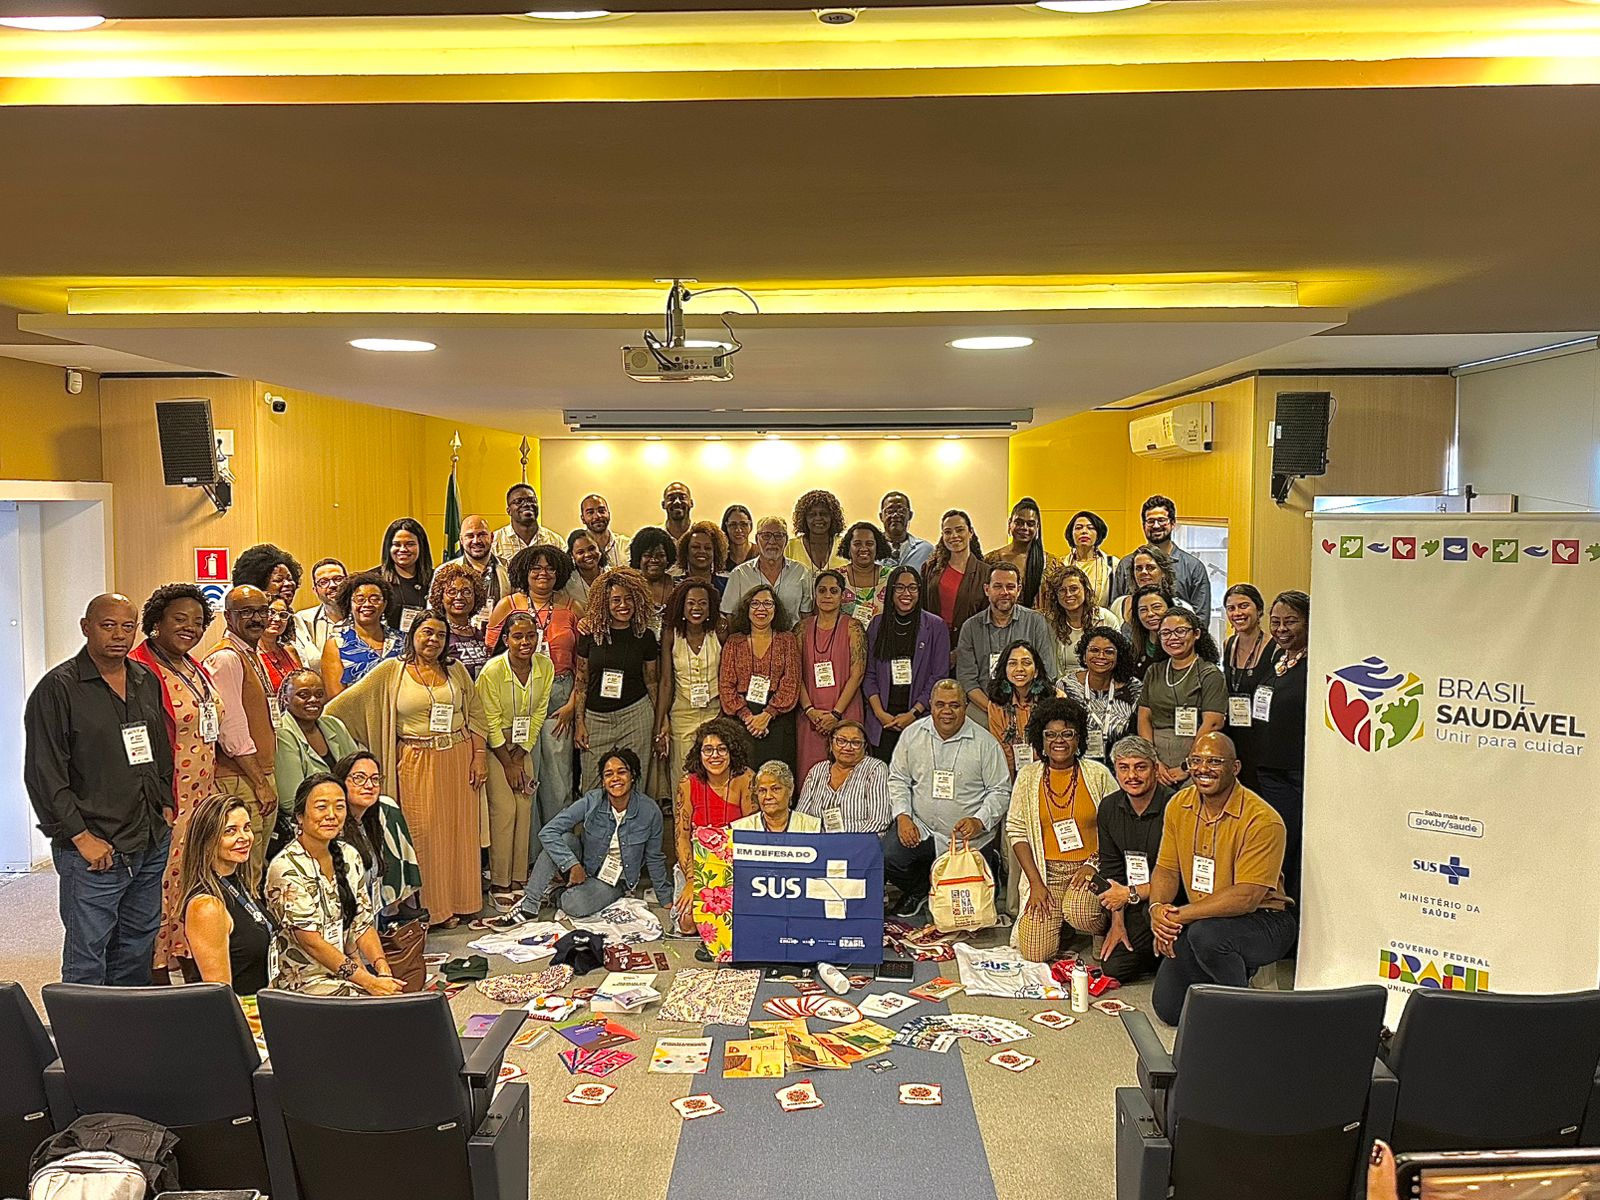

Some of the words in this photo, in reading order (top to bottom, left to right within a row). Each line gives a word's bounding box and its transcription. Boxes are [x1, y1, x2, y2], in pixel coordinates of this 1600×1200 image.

[1438, 678, 1536, 705] BRASIL
[1436, 704, 1586, 738] SAUDÁVEL
[1436, 728, 1471, 744] Unir
[1478, 735, 1517, 750] para
[1524, 735, 1584, 756] cuidar
[1424, 810, 1442, 818] Saiba
[1415, 818, 1478, 832] gov.br/saude
[736, 848, 753, 856] EM
[754, 850, 794, 858] DEFESA
[1412, 859, 1437, 873] SUS
[751, 876, 802, 899] SUS
[1399, 892, 1462, 910] MINISTÉRIO
[1466, 904, 1480, 913] DA
[1422, 907, 1457, 920] SAÚDE
[1390, 940, 1439, 956] GOVERNO
[1443, 951, 1490, 967] FEDERAL
[980, 960, 1010, 971] SUS
[1378, 949, 1489, 992] BRASIL
